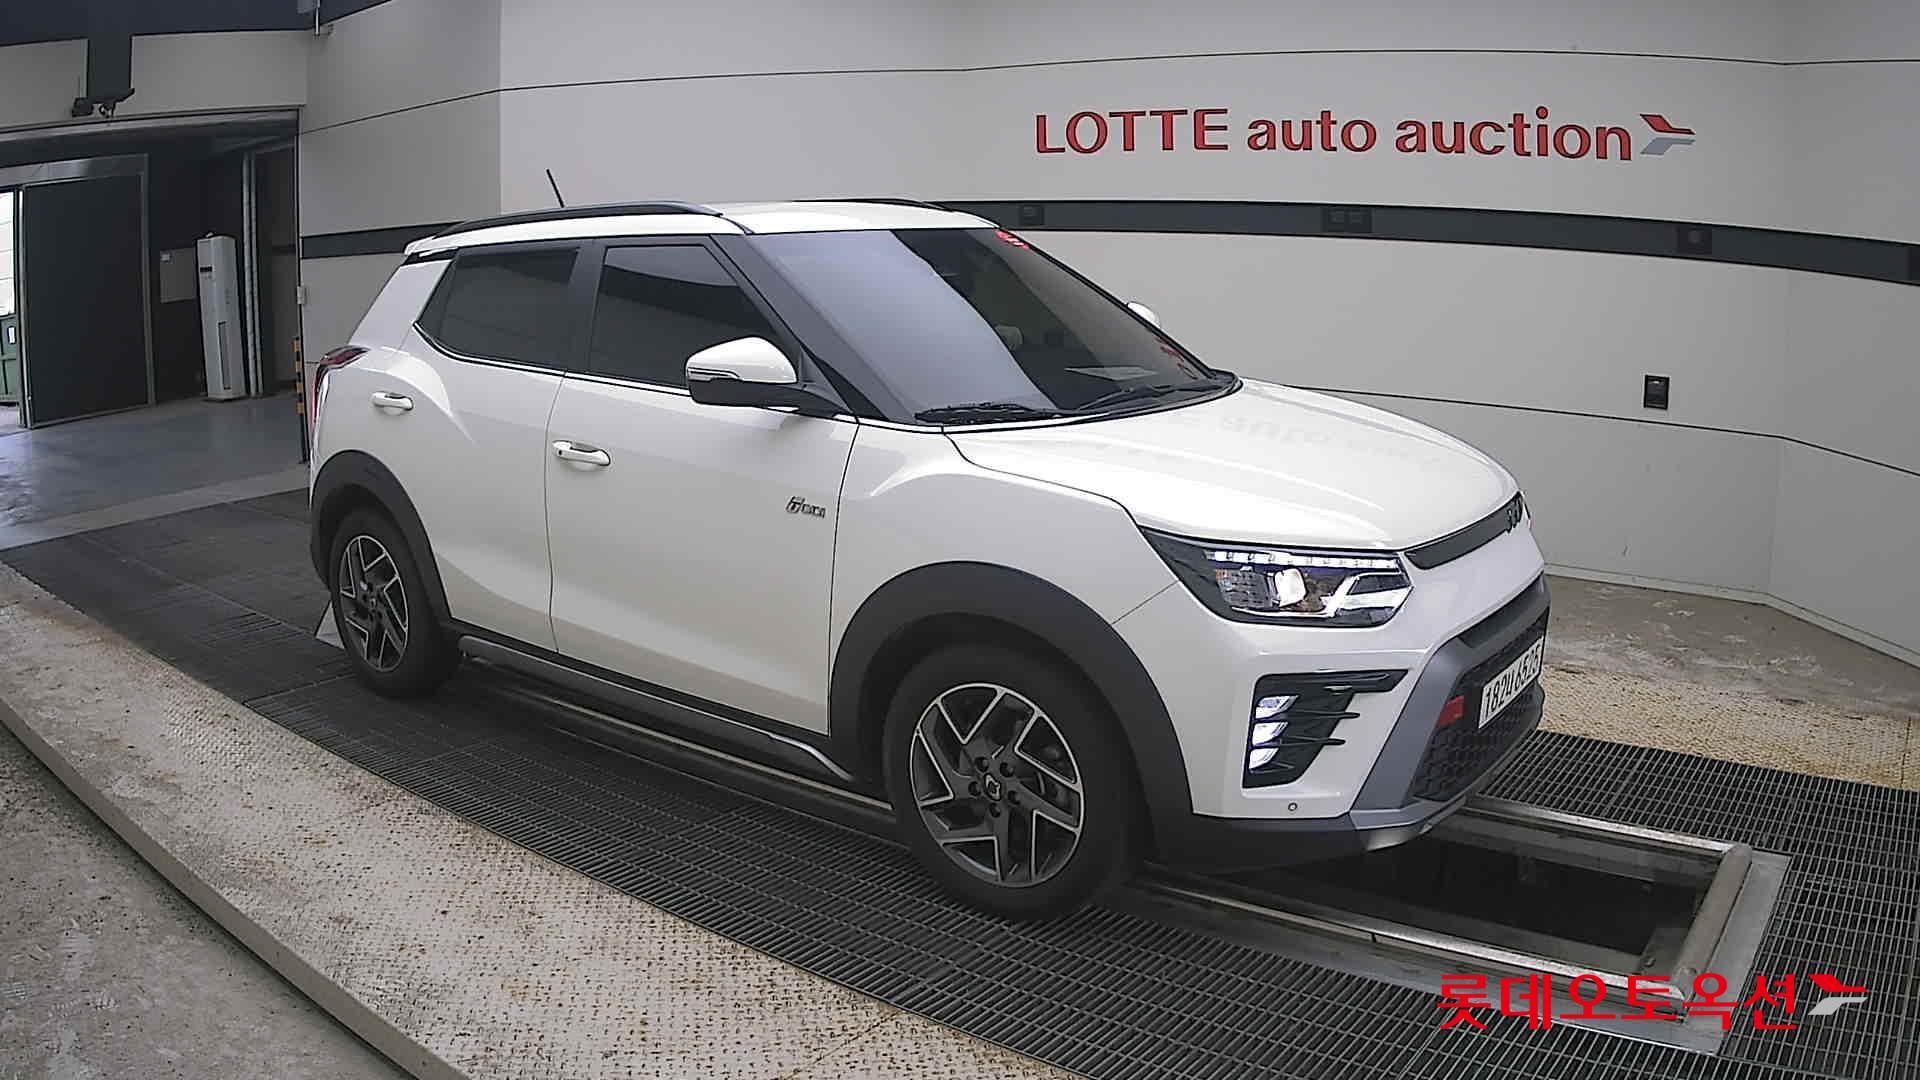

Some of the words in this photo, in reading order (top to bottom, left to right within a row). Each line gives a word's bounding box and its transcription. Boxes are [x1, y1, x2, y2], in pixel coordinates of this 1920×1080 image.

[1035, 108, 1229, 154] LOTTE
[1246, 110, 1377, 153] auto
[1395, 106, 1632, 161] auction
